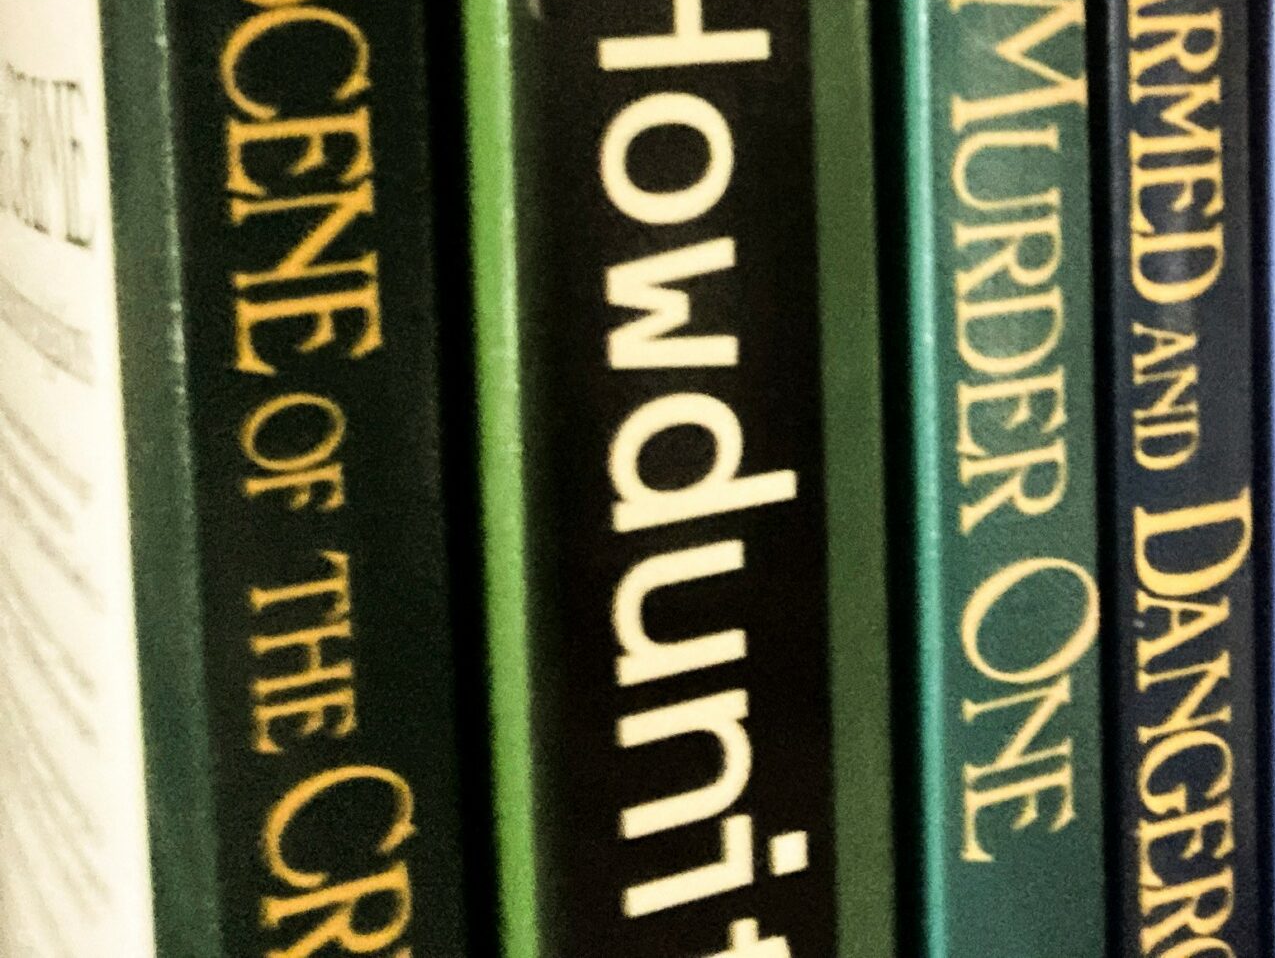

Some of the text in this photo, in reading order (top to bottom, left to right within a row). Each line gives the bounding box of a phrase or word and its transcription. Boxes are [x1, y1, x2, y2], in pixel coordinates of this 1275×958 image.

[242, 393, 348, 512] OF
[1131, 322, 1199, 471] AND
[249, 549, 358, 754] THE
[958, 556, 1101, 863] ONE
[1134, 487, 1254, 958] DANGER
[260, 764, 417, 958] CR
